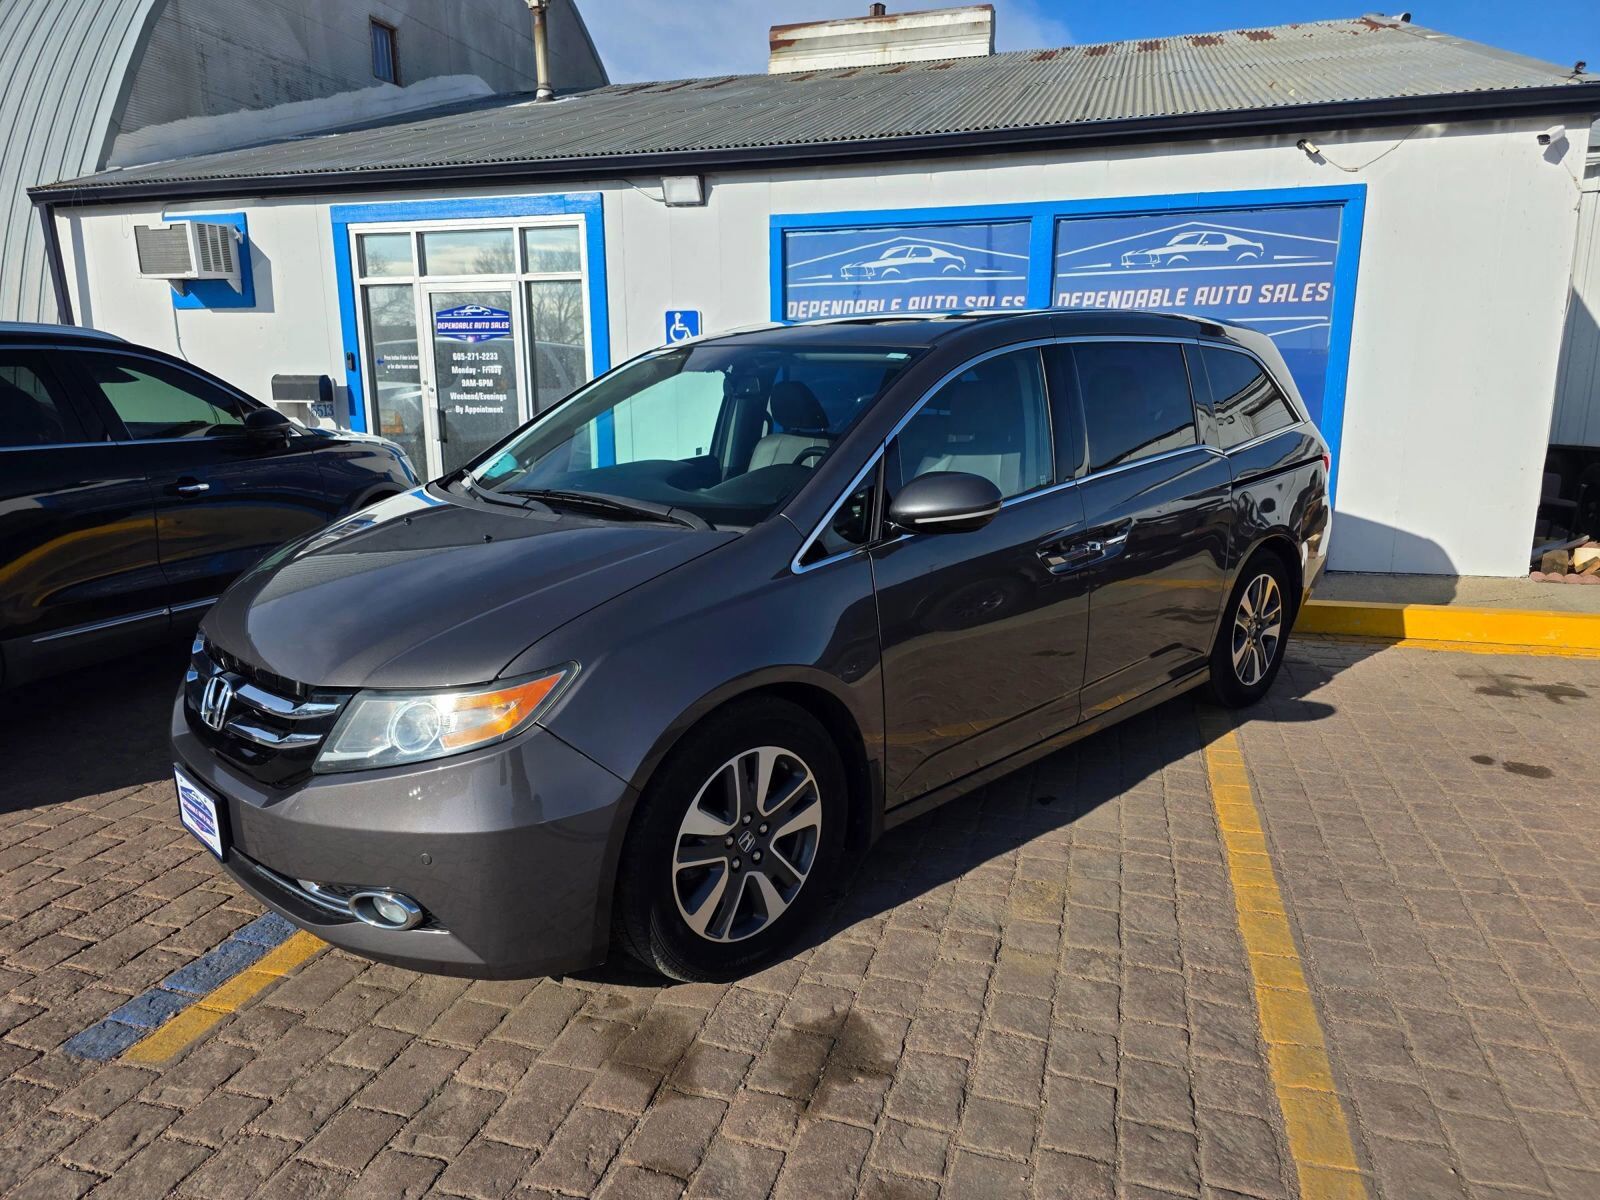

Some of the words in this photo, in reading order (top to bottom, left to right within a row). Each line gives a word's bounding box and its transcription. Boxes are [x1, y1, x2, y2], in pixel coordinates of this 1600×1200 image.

[1057, 288, 1188, 309] DEPENDABLE
[1194, 285, 1253, 305] AUTO
[1258, 282, 1331, 303] SALES
[788, 298, 902, 318] DEPENDABLE
[474, 321, 490, 329] AUTO
[490, 321, 510, 329] SALES
[451, 366, 476, 375] Monday
[450, 392, 507, 401] Weekend/Evenings
[455, 405, 464, 414] By
[465, 405, 503, 414] Appointment
